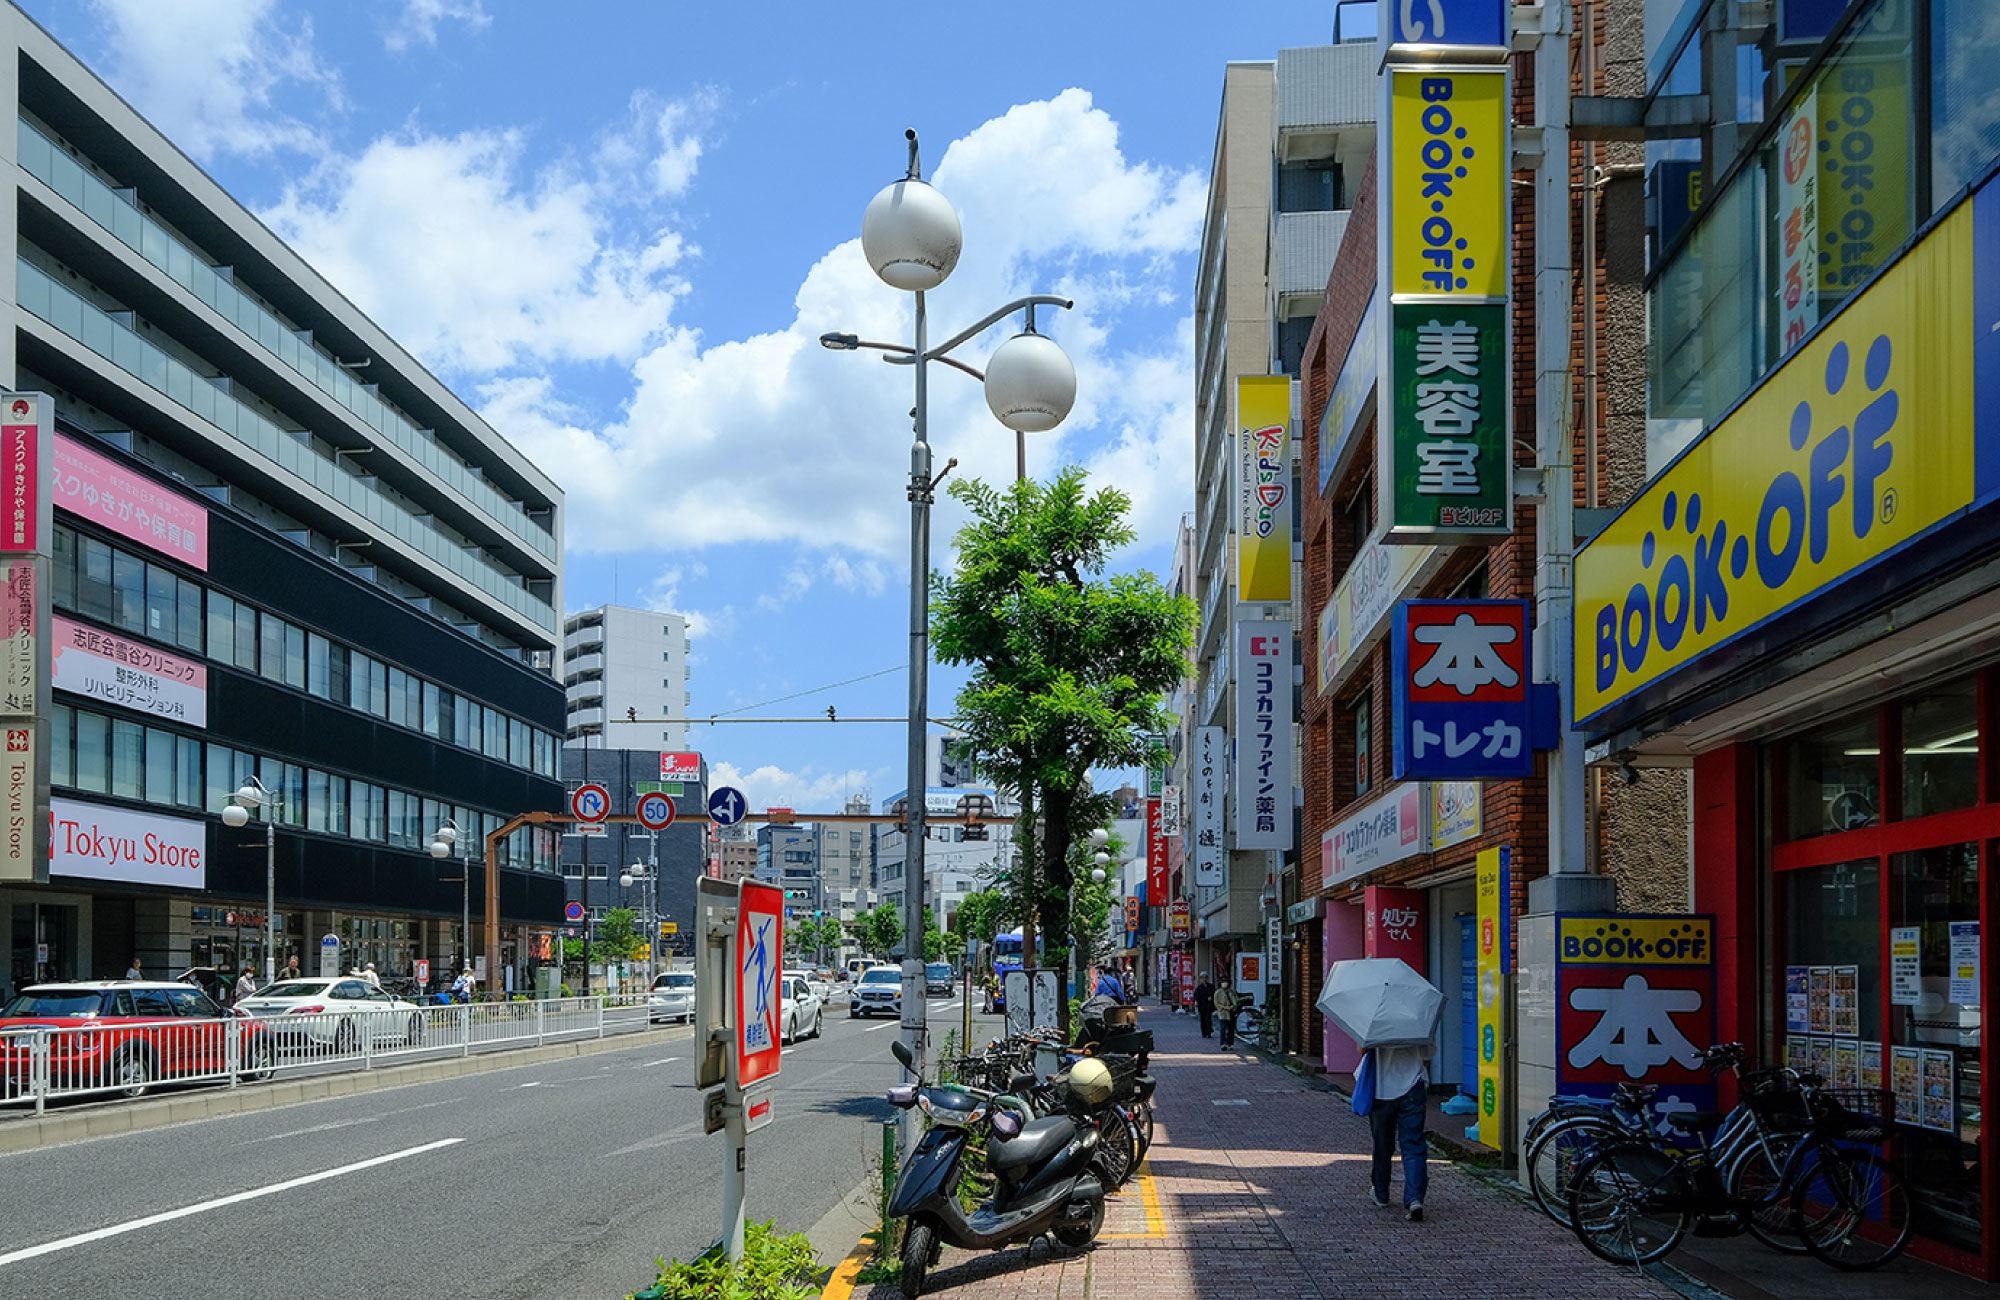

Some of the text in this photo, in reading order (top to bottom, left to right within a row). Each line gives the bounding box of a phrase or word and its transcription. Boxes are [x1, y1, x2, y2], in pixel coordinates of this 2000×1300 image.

[1415, 319, 1480, 494] 美容室
[14, 429, 26, 544] アスクゆきがや保育園
[1441, 506, 1502, 526] 当ビル2F
[72, 628, 195, 681] 志匠会雪谷クリニック
[115, 665, 160, 694] 整形外科
[1413, 612, 1520, 697] 本
[84, 677, 186, 719] リハビリテーション科
[1256, 662, 1275, 833] ココカラファイン薬局
[1413, 719, 1522, 759] トレカ
[9, 761, 26, 859] Tokyu Store
[645, 802, 668, 820] 50
[59, 820, 201, 870] Tokyu Store
[1381, 906, 1419, 928] 処方
[1387, 928, 1413, 941] せん
[1567, 974, 1704, 1079] 本
